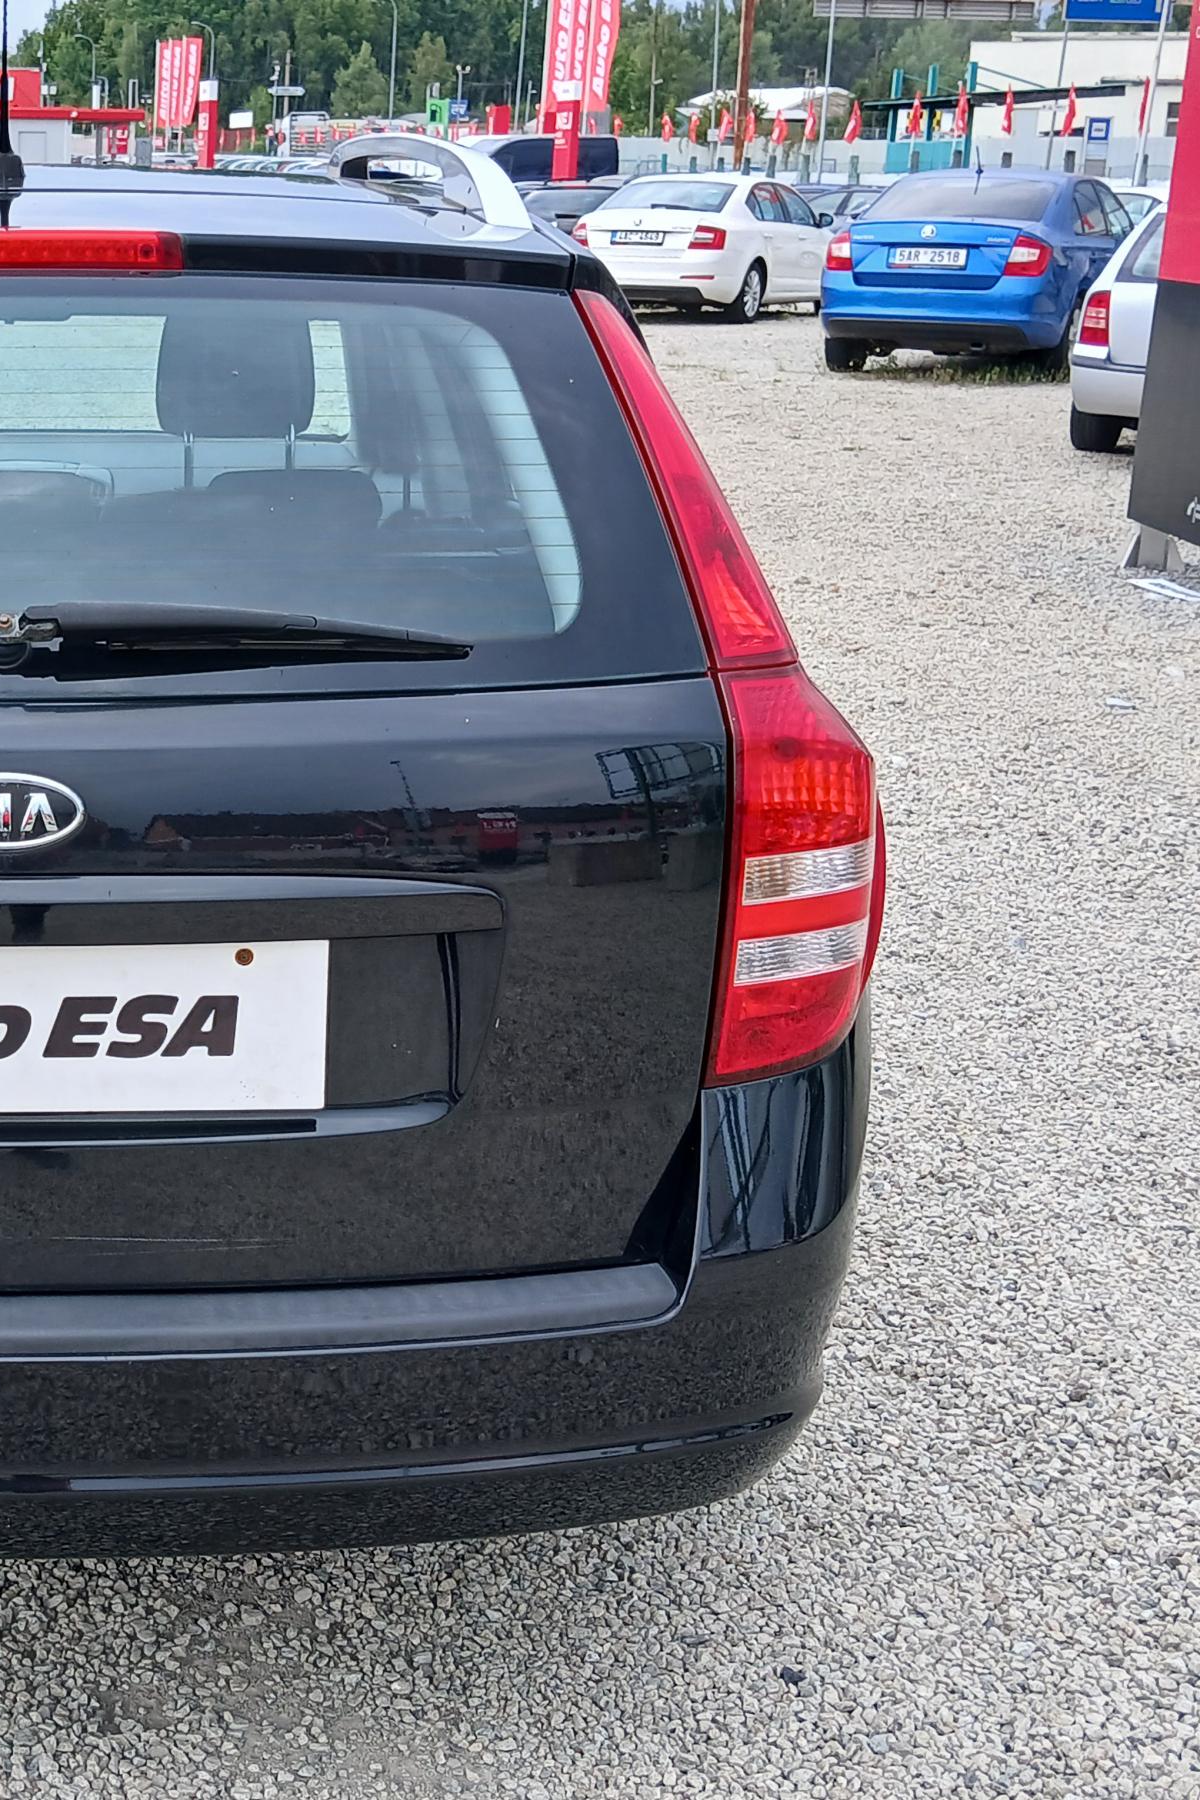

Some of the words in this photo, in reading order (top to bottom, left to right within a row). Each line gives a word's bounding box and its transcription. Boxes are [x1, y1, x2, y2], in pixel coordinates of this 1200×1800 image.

[592, 23, 611, 100] Auto
[898, 249, 921, 262] 5AR
[929, 250, 960, 263] 2518
[42, 994, 240, 1058] ESA
